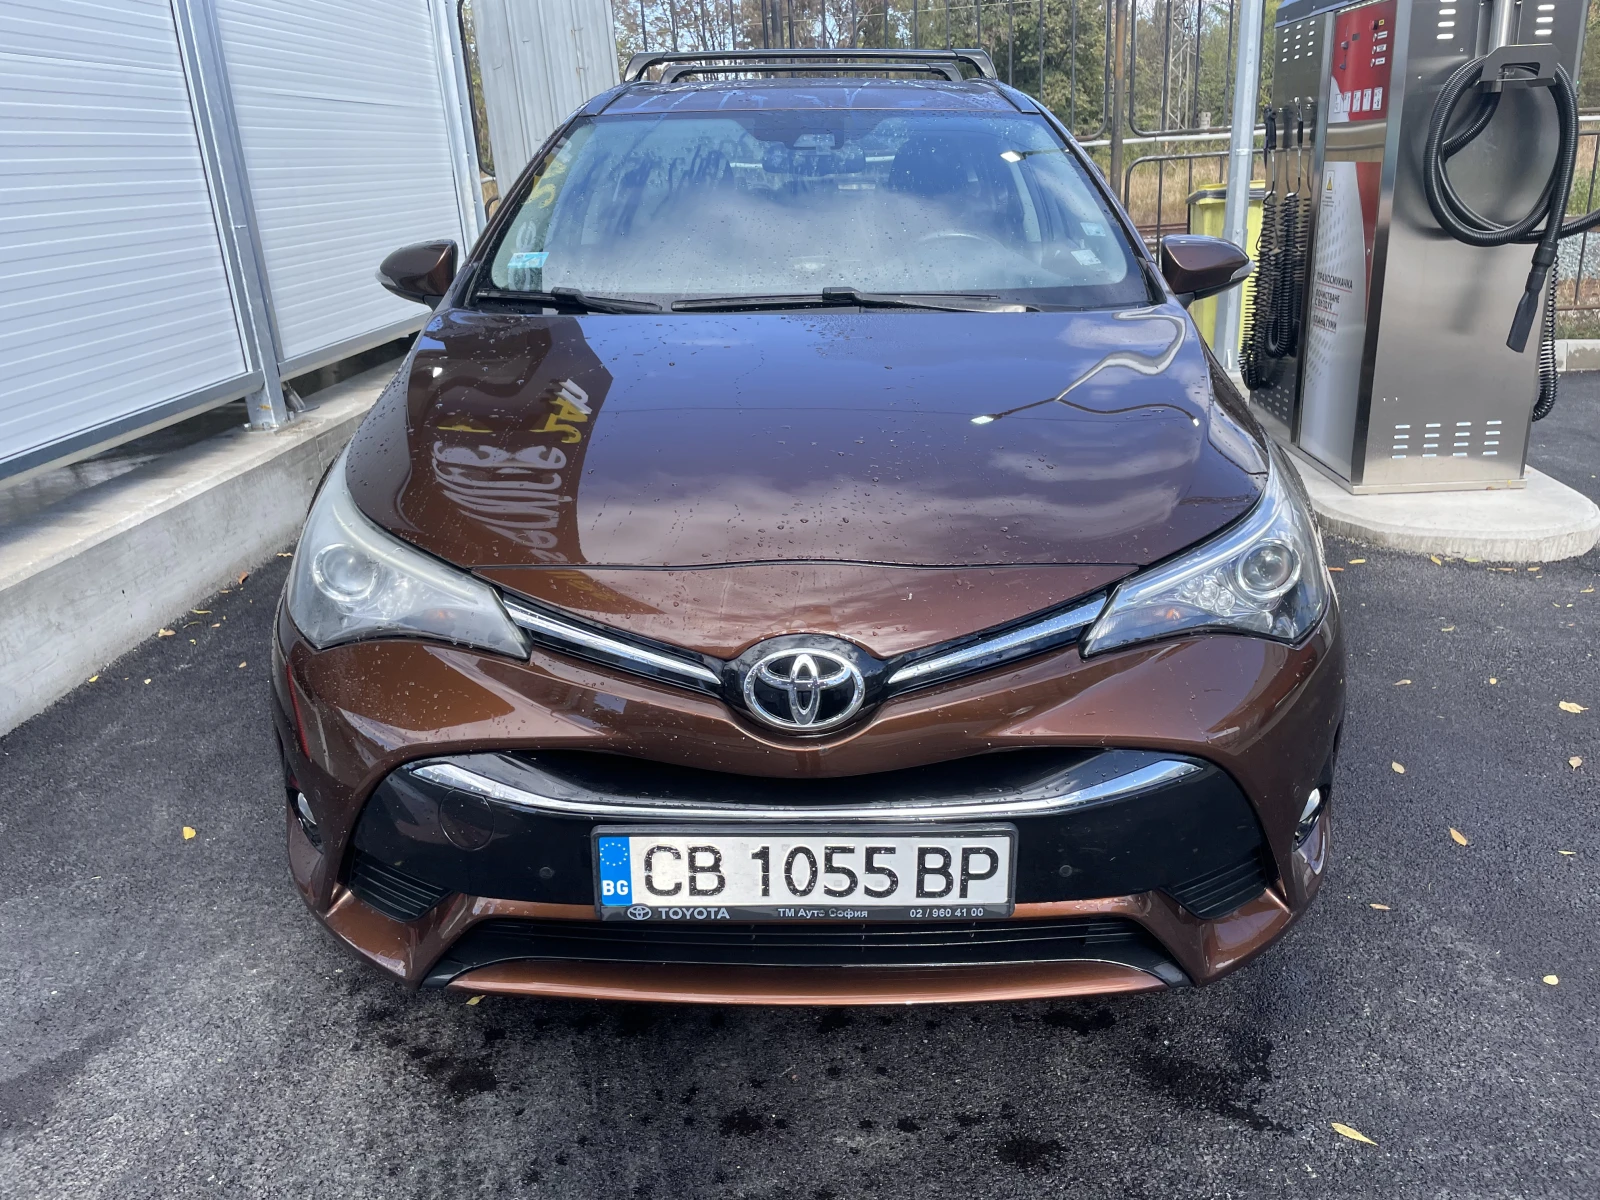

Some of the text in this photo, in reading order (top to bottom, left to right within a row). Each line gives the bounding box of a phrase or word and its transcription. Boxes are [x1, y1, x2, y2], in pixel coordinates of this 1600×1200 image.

[751, 845, 899, 898] 1055
[602, 879, 629, 896] BG
[657, 907, 731, 920] TOYOTA
[828, 908, 868, 920] София
[909, 908, 923, 918] 02
[932, 908, 952, 918] 960
[955, 907, 968, 917] 41
[970, 907, 984, 917] 00
